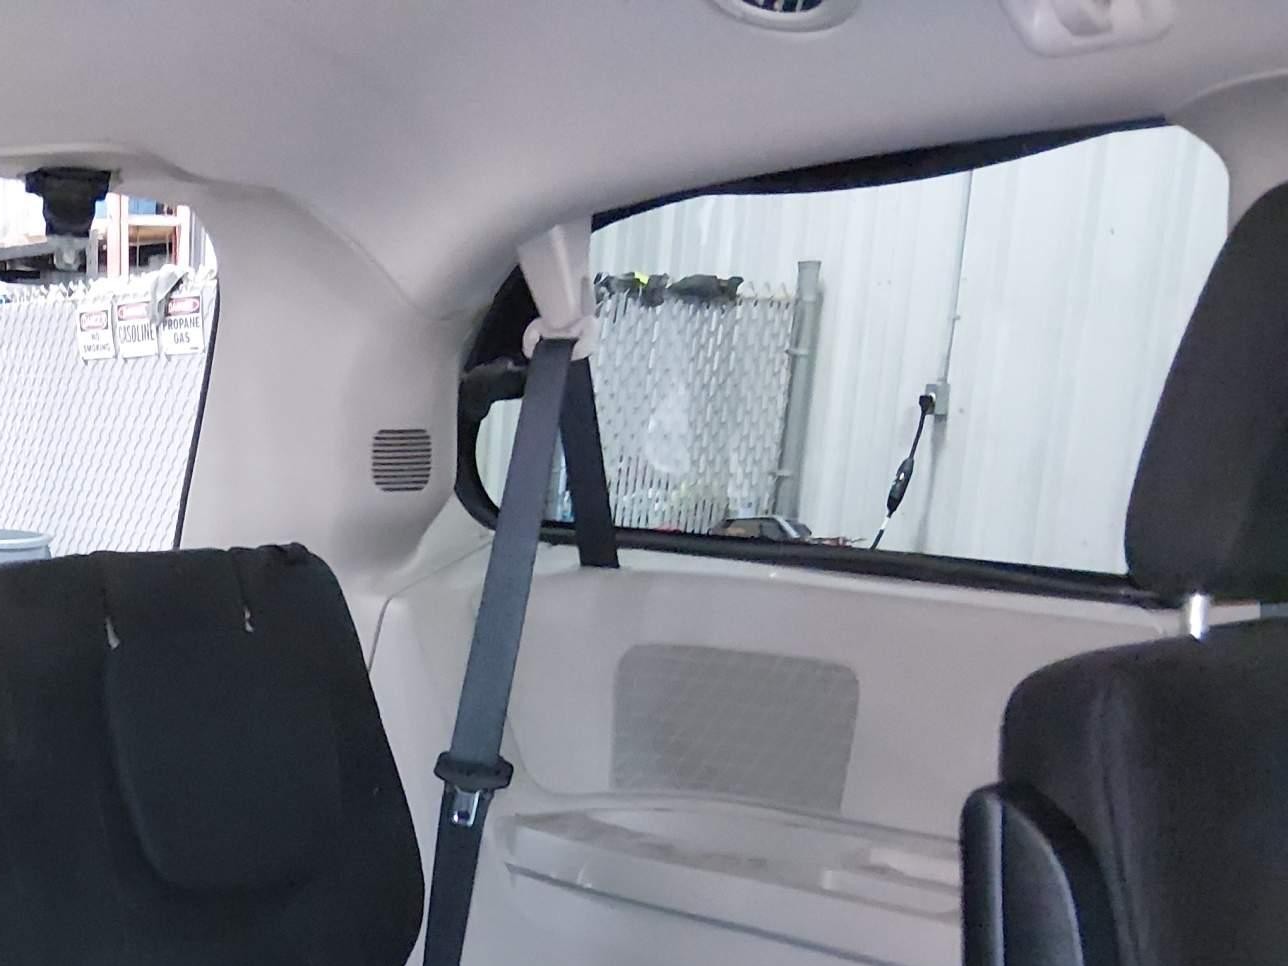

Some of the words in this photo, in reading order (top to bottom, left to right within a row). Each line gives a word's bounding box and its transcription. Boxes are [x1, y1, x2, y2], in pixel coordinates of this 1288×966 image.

[163, 317, 201, 331] PROPANE
[118, 321, 155, 344] GASOLINE
[174, 331, 190, 344] GAS
